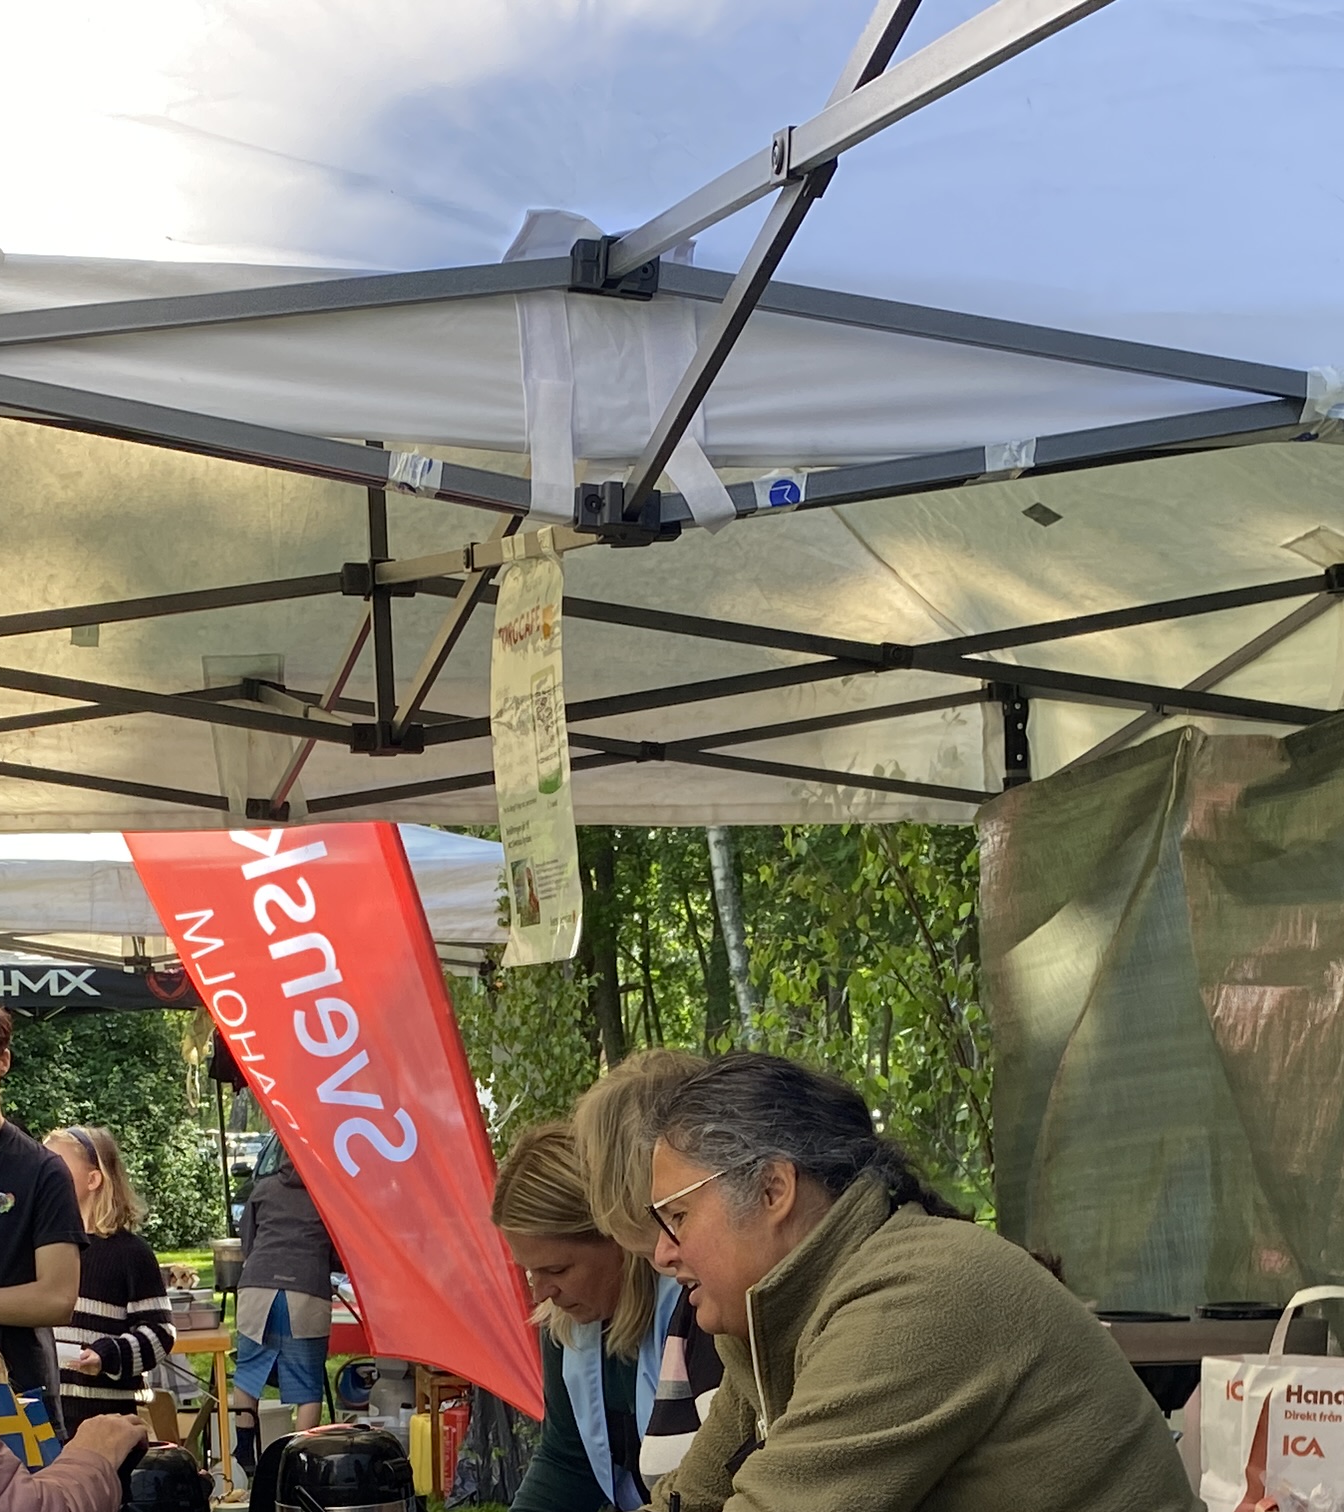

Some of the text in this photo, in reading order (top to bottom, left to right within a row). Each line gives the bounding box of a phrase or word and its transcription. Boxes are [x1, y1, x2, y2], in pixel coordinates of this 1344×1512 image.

[1225, 1379, 1244, 1402] IC
[1284, 1410, 1317, 1422] Direkt
[1318, 1409, 1343, 1423] från
[1282, 1435, 1325, 1458] ICA
